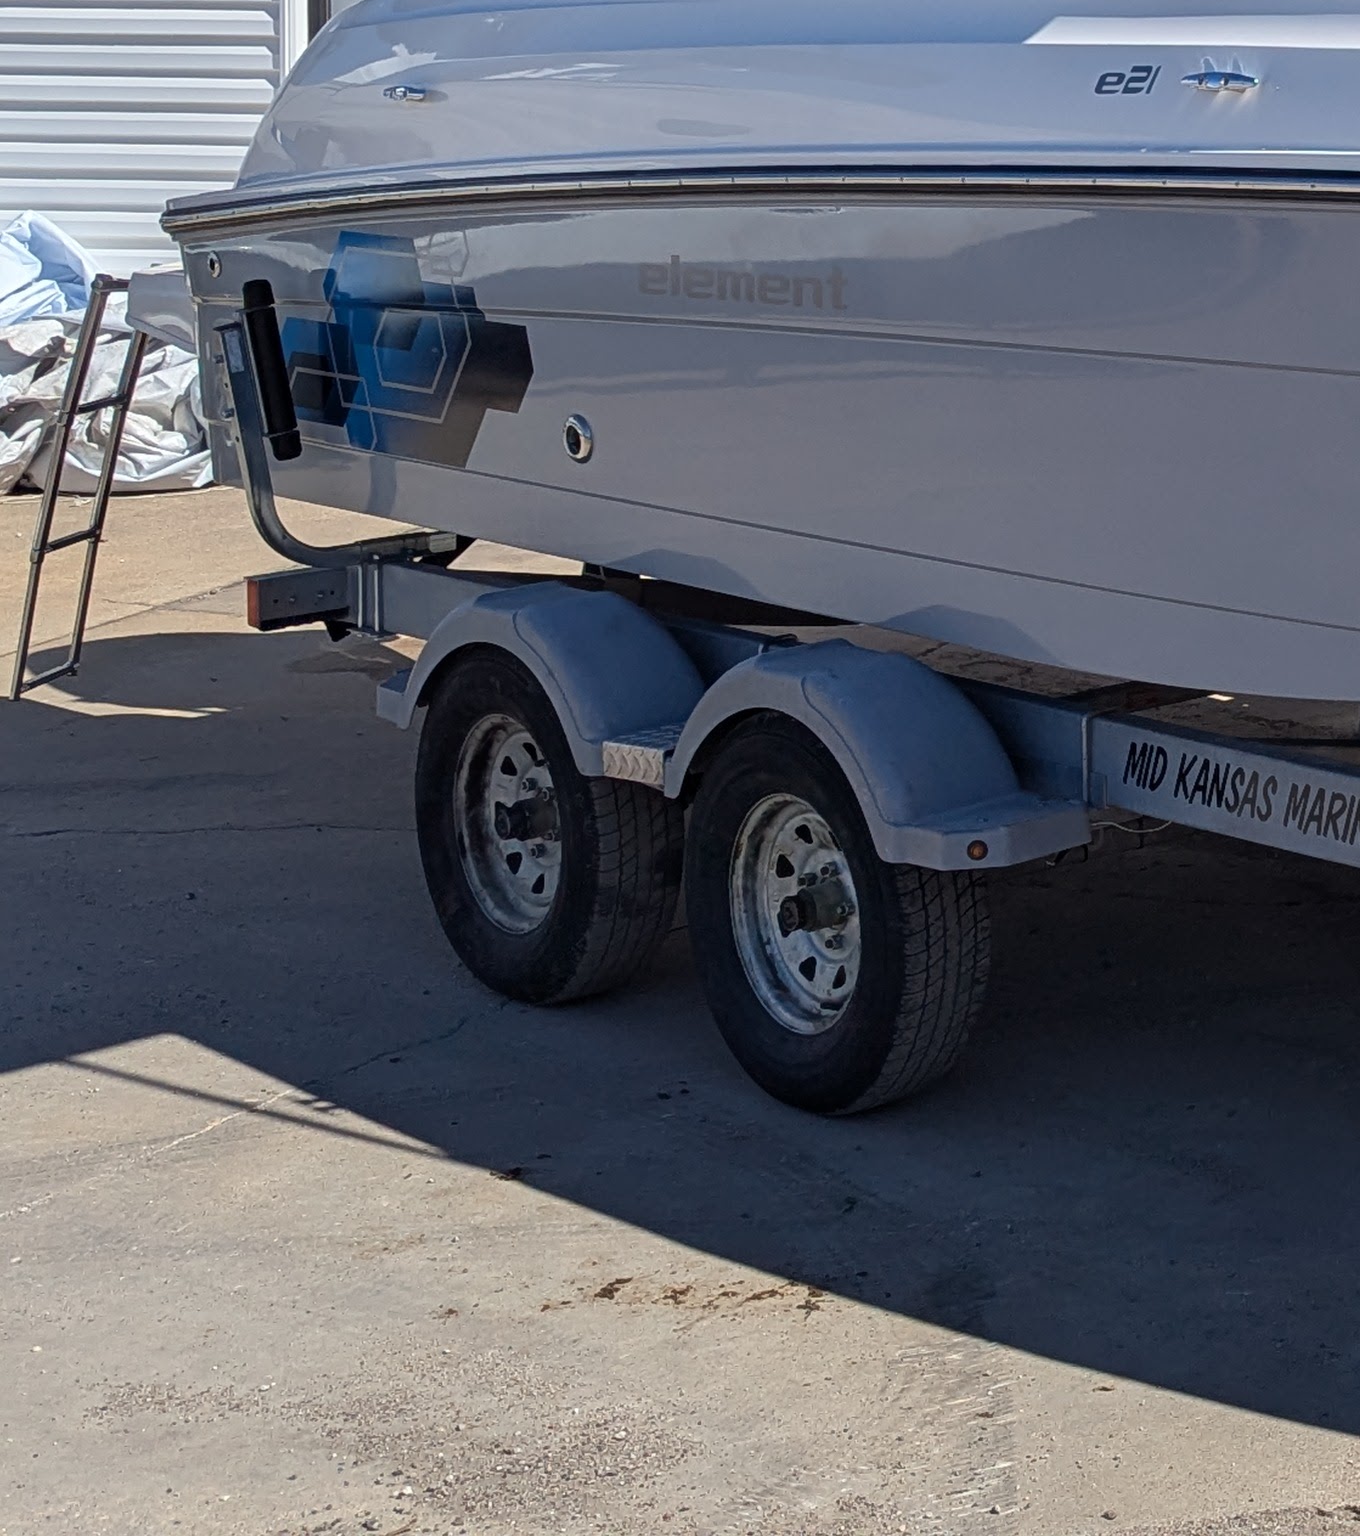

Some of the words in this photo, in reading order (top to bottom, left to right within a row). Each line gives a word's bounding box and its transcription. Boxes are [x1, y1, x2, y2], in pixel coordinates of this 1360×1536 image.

[1094, 65, 1162, 95] e21
[638, 254, 847, 310] element
[1122, 741, 1169, 792] MID
[1173, 752, 1278, 822] KANSAS
